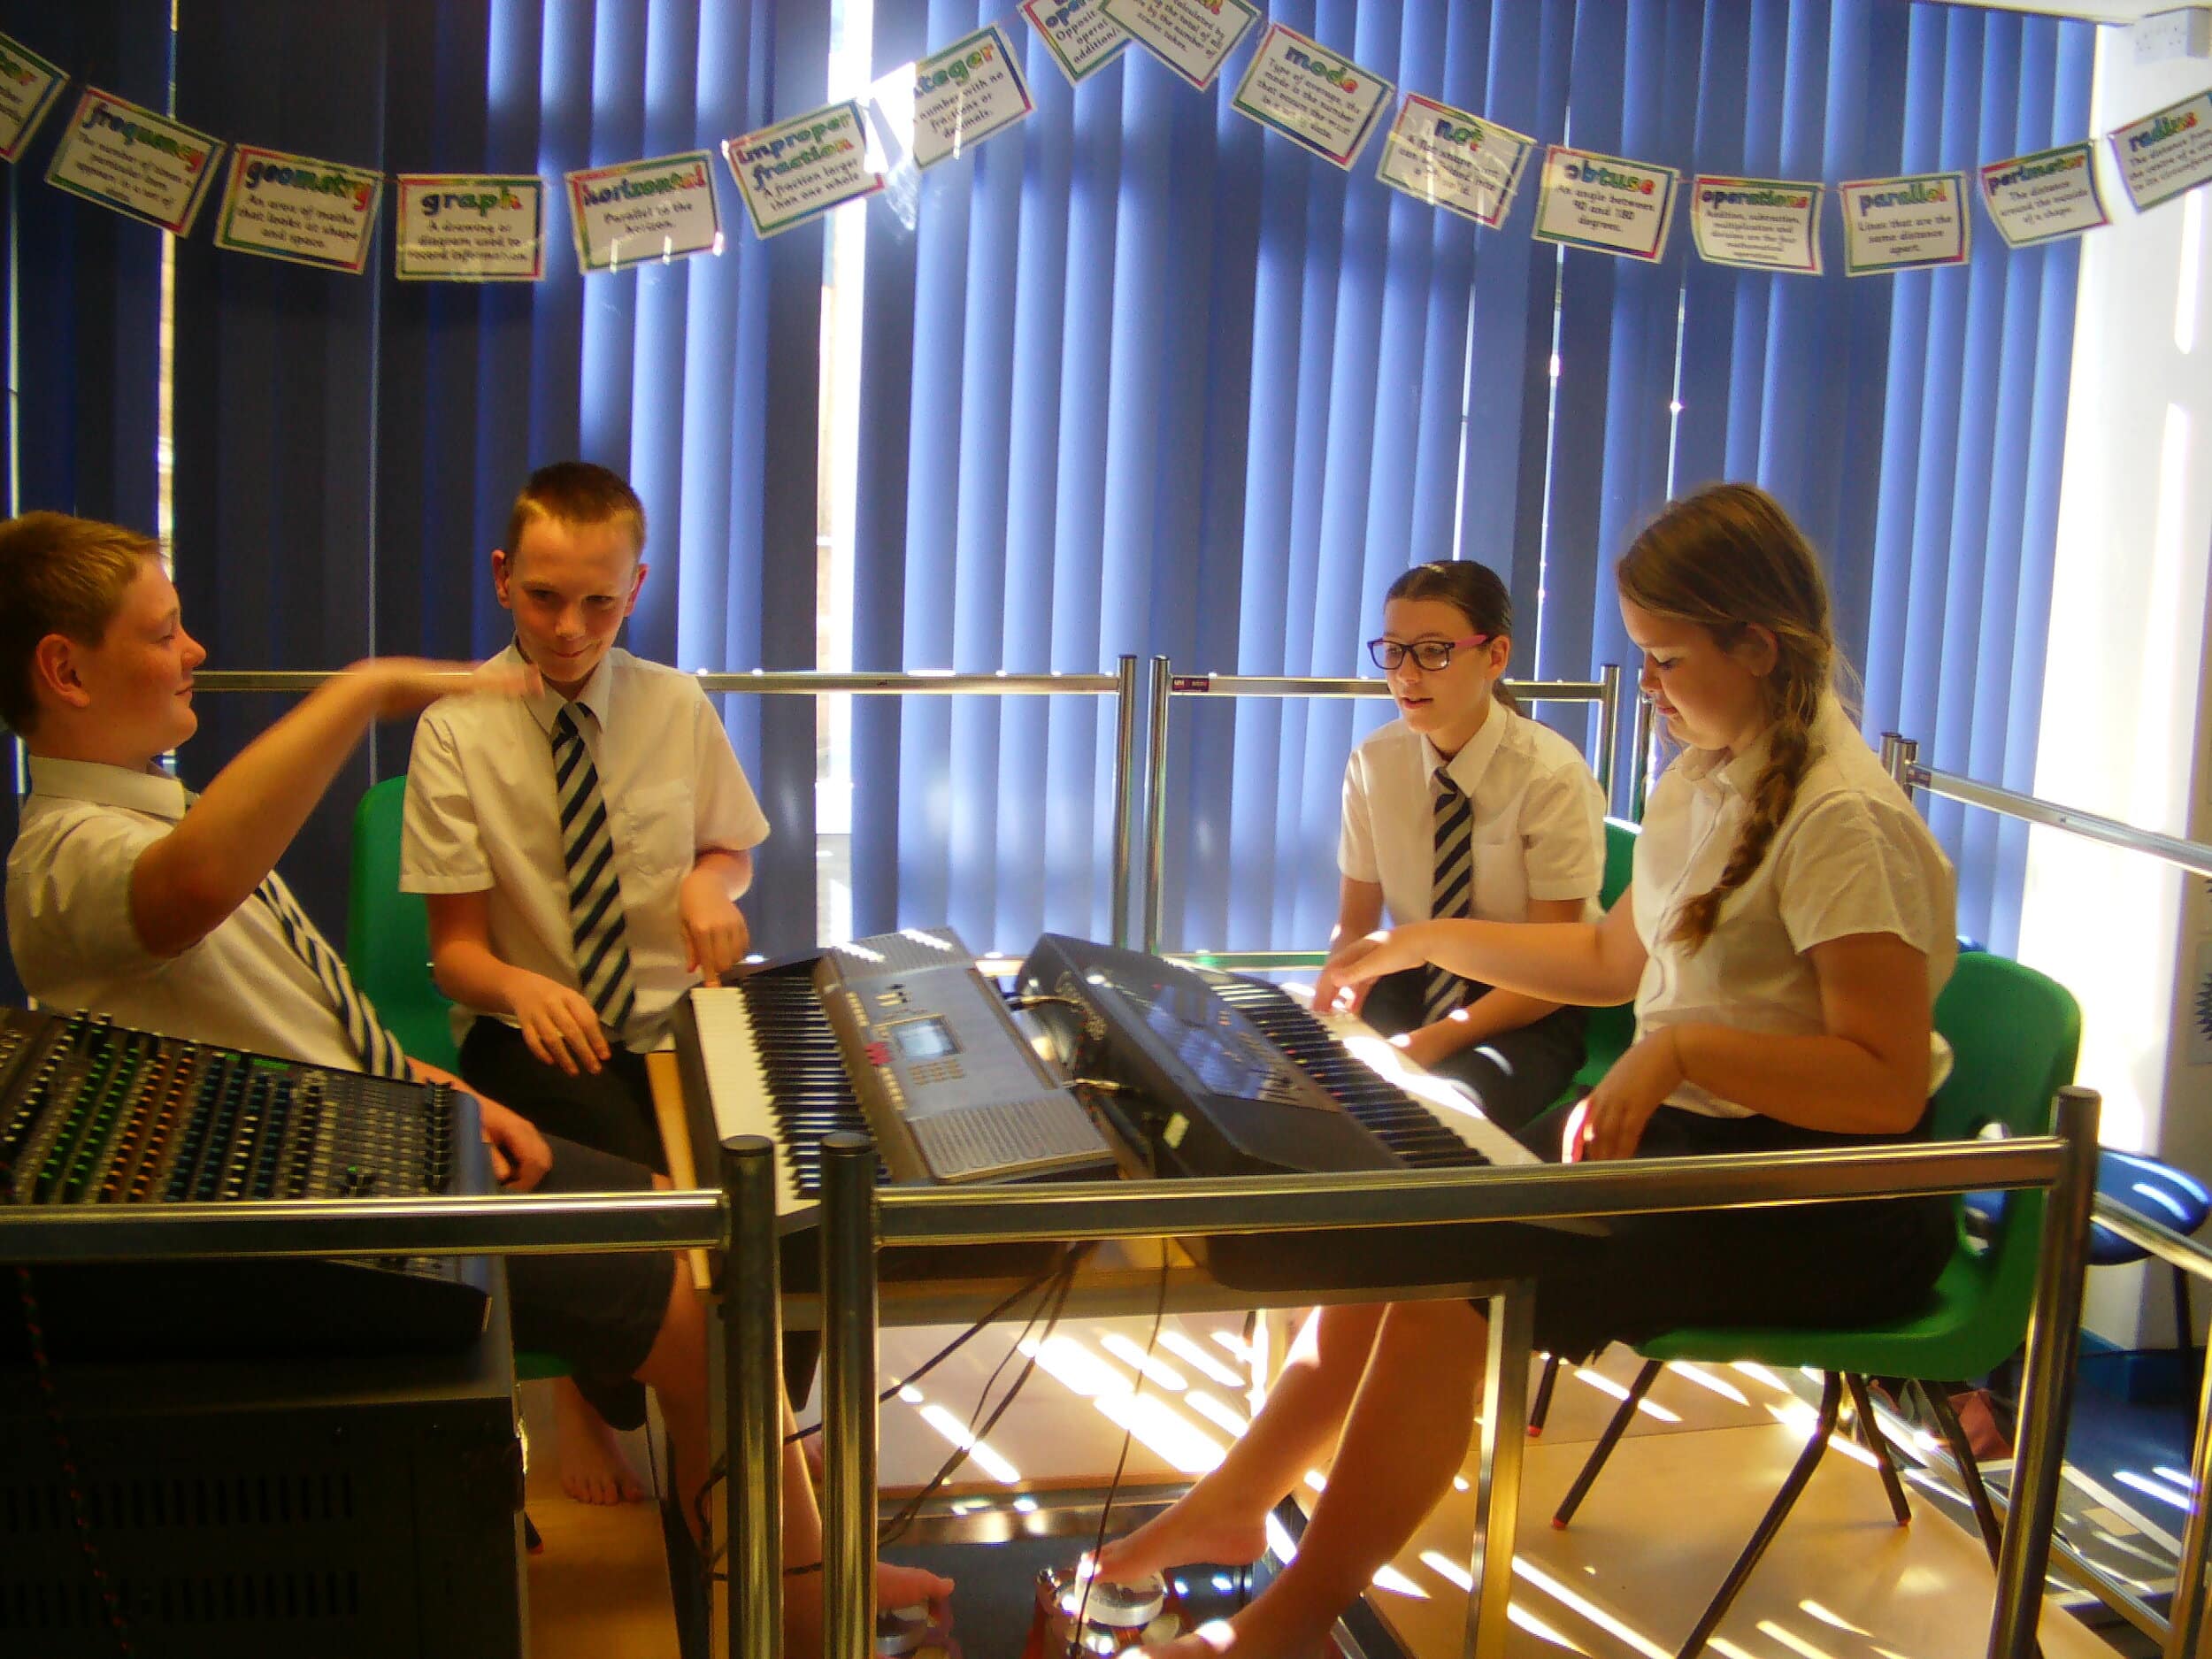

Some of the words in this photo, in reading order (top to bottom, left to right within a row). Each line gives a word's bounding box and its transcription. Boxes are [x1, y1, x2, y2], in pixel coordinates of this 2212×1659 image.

[1148, 5, 1158, 18] by
[1160, 13, 1173, 27] the
[1174, 26, 1204, 49] number
[1205, 48, 1217, 59] of
[1164, 4, 1178, 16] the
[1179, 15, 1200, 33] total
[1200, 31, 1211, 41] of
[1215, 27, 1225, 39] by
[1269, 58, 1290, 76] Type
[1293, 73, 1304, 86] of
[1285, 46, 1359, 94] mode
[919, 93, 960, 120] number
[963, 78, 988, 99] with
[989, 72, 1005, 84] no
[1256, 80, 1278, 95] that
[1279, 93, 1308, 112] occurs
[1310, 108, 1326, 121] the
[1262, 95, 1272, 104] in
[1265, 71, 1289, 89] mode
[1302, 91, 1318, 104] the
[1320, 101, 1355, 123] number
[930, 101, 979, 134] fractions
[982, 93, 993, 104] or
[81, 102, 205, 173] frequency
[1434, 119, 1484, 152] net
[2129, 111, 2198, 152] radius
[99, 143, 135, 163] number
[753, 138, 855, 191] fraction
[2130, 156, 2147, 166] The
[2150, 139, 2188, 159] distance
[2130, 171, 2145, 180] the
[2146, 157, 2176, 173] centre
[2176, 151, 2187, 162] of
[246, 162, 372, 211] geometry
[581, 164, 707, 206] horizontal
[764, 187, 772, 198] A
[776, 172, 821, 198] fraction
[822, 157, 858, 178] larger
[1564, 159, 1655, 196] obtuse
[1988, 155, 2086, 196] perimeter
[2009, 190, 2028, 201] The
[2031, 180, 2071, 196] distance
[250, 195, 265, 207] An
[267, 201, 296, 211] area
[301, 205, 313, 218] of
[316, 210, 355, 226] maths
[422, 185, 523, 217] graph
[771, 196, 798, 212] than
[802, 188, 822, 199] one
[1556, 185, 1572, 196] An
[1576, 189, 1606, 204] angle
[1609, 194, 1655, 211] between
[1589, 206, 1610, 217] and
[1616, 209, 1635, 220] 180
[1702, 190, 1809, 210] operations
[1859, 181, 1947, 217] parallel
[2035, 198, 2052, 209] the
[2053, 188, 2089, 204] outside
[239, 208, 265, 221] that
[268, 214, 301, 228] looks
[322, 226, 358, 242] shape
[442, 221, 495, 234] drawing
[603, 205, 652, 225] Parallel
[657, 206, 671, 217] to
[673, 202, 693, 212] the
[1857, 220, 1886, 232] Lines
[1889, 219, 1913, 229] that
[1935, 215, 1952, 224] the
[2024, 214, 2034, 225] of
[262, 228, 286, 241] and
[418, 235, 471, 248] diagram
[475, 236, 503, 247] used
[508, 236, 521, 246] to
[1762, 233, 1778, 242] the
[1868, 234, 1897, 245] same
[1900, 229, 1945, 242] distance
